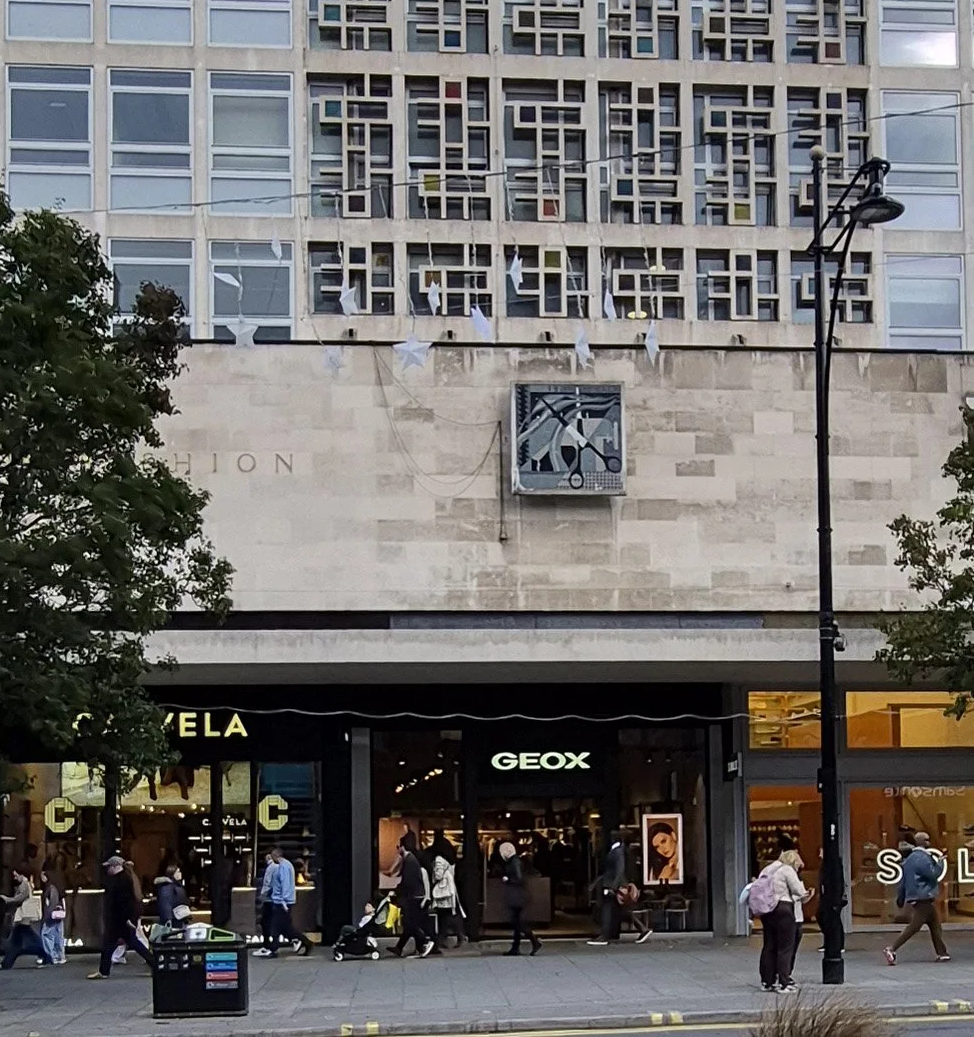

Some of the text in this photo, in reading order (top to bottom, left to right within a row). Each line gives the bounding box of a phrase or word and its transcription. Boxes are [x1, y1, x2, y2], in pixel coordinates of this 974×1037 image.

[491, 751, 591, 770] GEOX
[44, 796, 76, 833] C
[258, 794, 289, 831] C
